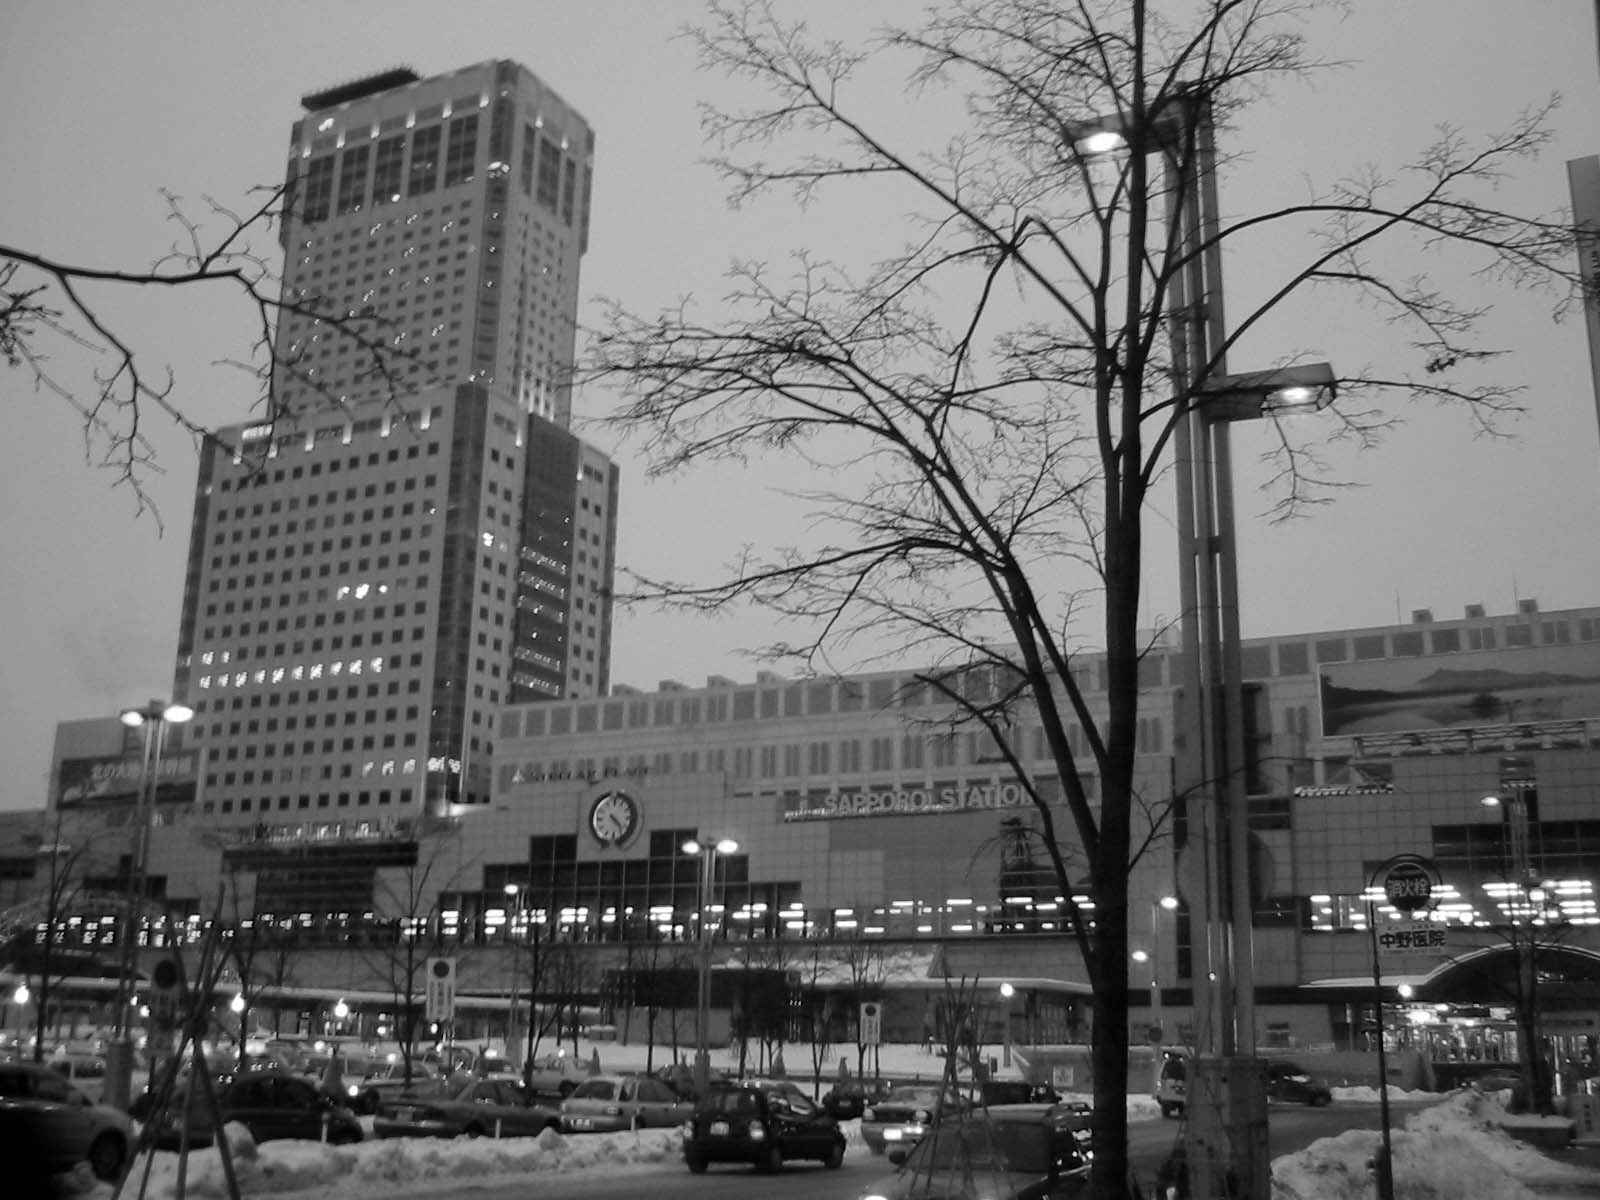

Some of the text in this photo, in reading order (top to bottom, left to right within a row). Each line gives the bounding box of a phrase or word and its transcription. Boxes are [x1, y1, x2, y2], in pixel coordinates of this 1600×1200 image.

[825, 790, 928, 812] SAPPORO
[1387, 879, 1429, 897] 消火栓
[1380, 930, 1446, 948] 中野医院
